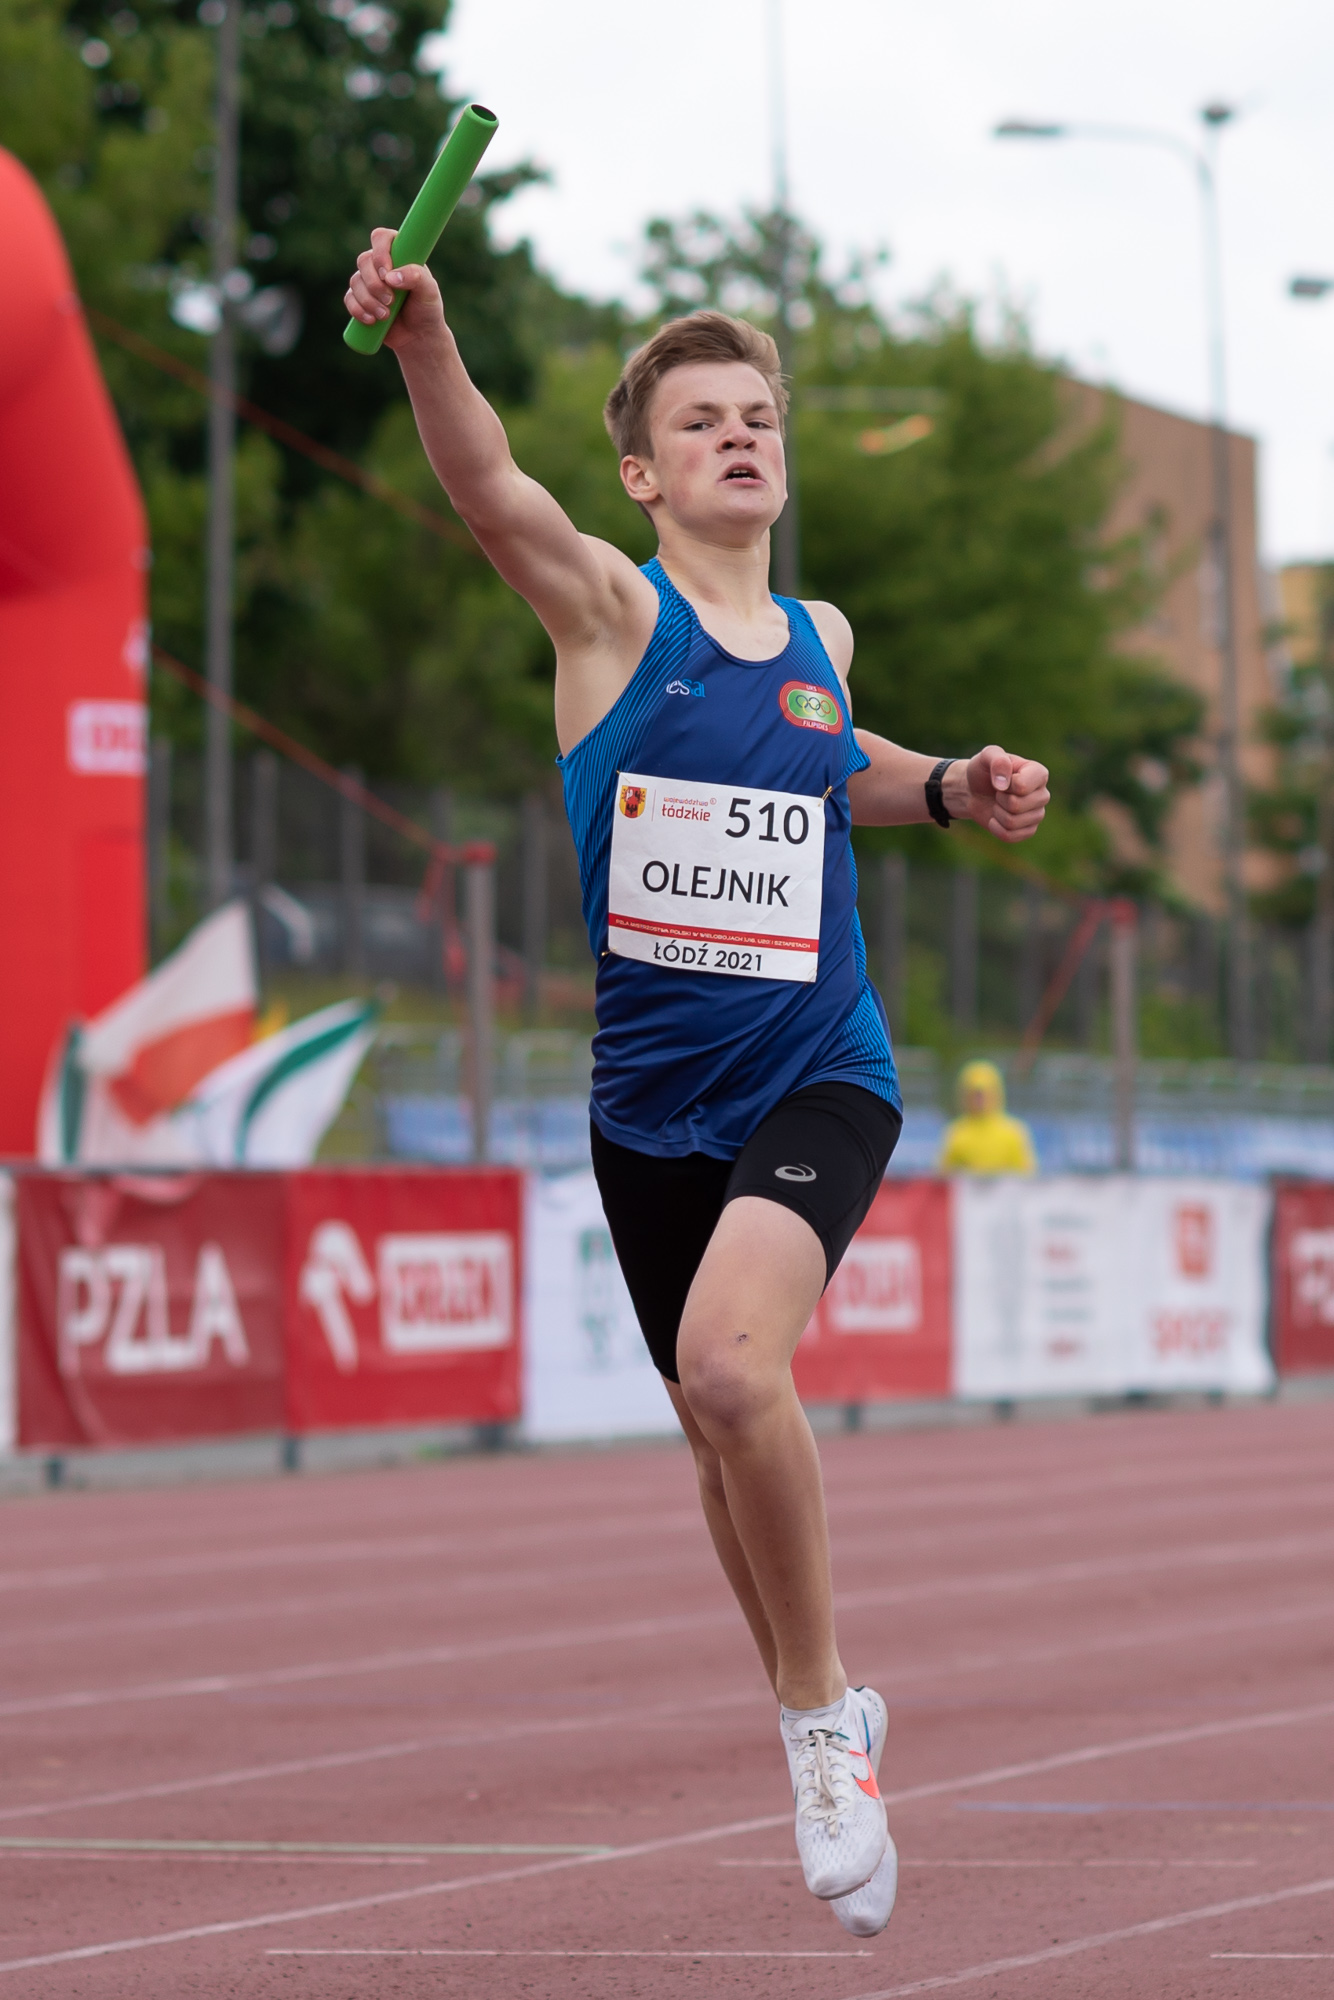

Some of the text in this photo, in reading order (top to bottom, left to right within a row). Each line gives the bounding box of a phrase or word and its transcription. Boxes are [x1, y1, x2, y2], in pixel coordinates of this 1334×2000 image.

[661, 804, 711, 822] łódzkie
[663, 797, 709, 807] województwo
[725, 797, 809, 845] 510
[642, 860, 791, 908] OLEJNIK
[670, 929, 692, 937] POLSKI
[653, 939, 762, 972] ŁÓDŹ 2021
[58, 1240, 249, 1376] PZLA
